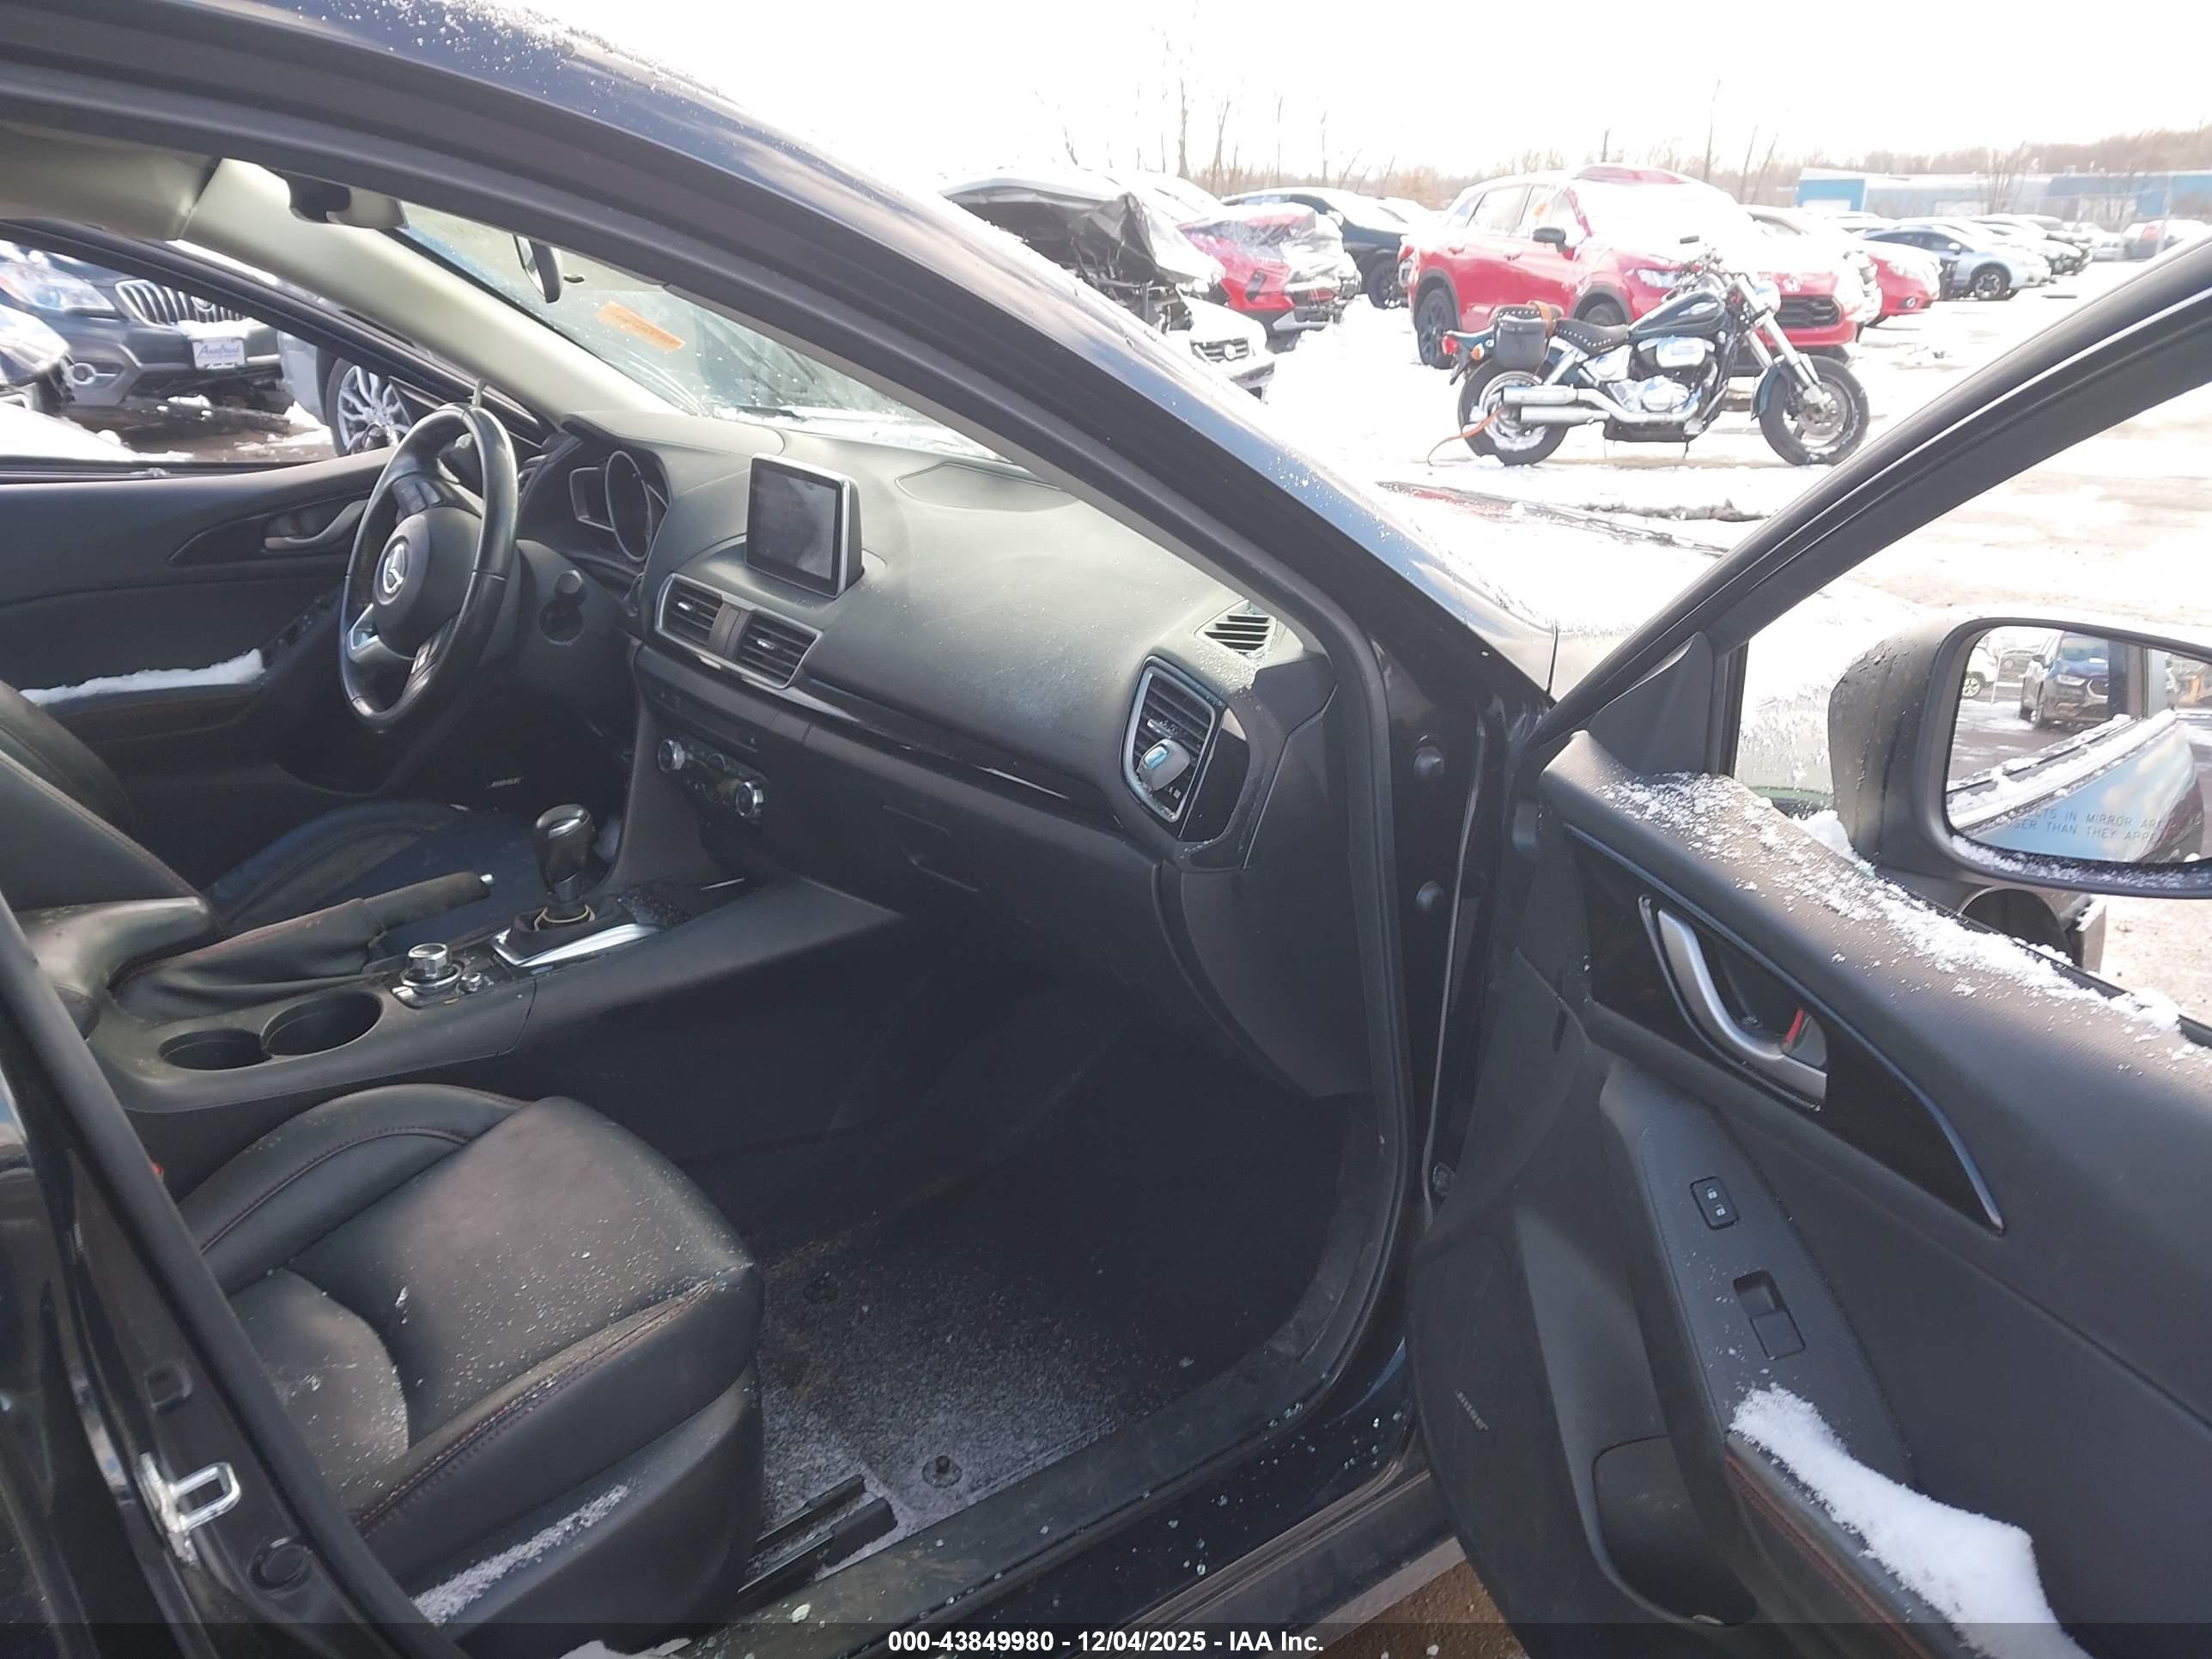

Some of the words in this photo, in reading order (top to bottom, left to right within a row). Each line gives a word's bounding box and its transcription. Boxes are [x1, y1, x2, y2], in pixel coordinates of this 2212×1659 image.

[2065, 810, 2077, 822] IN
[2086, 812, 2133, 826] MIRROR
[2046, 822, 2077, 835] THAN
[2087, 826, 2118, 839] THEY
